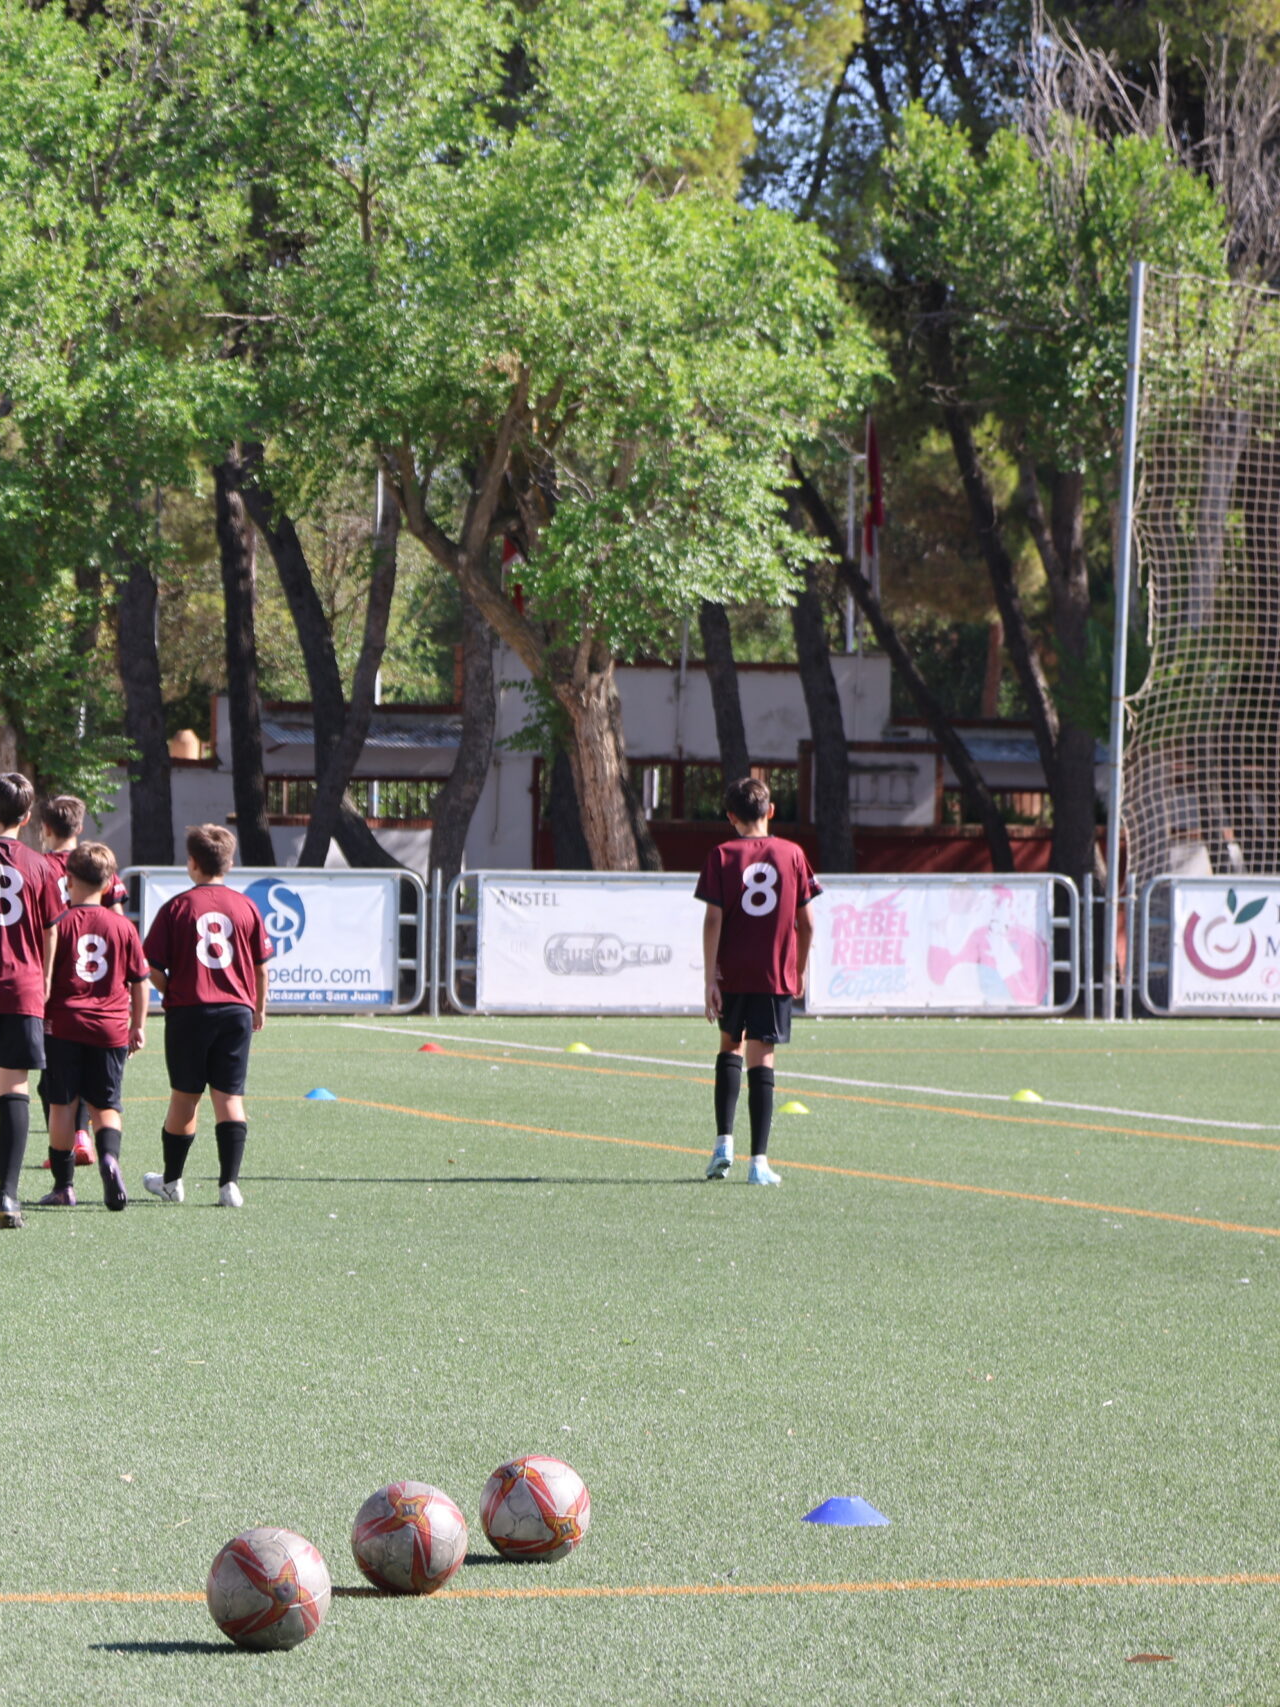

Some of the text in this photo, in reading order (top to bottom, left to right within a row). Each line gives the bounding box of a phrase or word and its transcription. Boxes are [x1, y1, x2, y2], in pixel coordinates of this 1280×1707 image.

[742, 862, 778, 916] 8
[830, 903, 910, 938] REBEL
[196, 911, 234, 970] 8
[831, 939, 906, 966] REBEL
[75, 933, 108, 982] 8
[267, 964, 371, 983] pedro.com
[308, 991, 322, 1001] de
[325, 990, 348, 1001] San
[350, 990, 379, 1001] Juan
[1184, 992, 1268, 1003] APOSTAMOS
